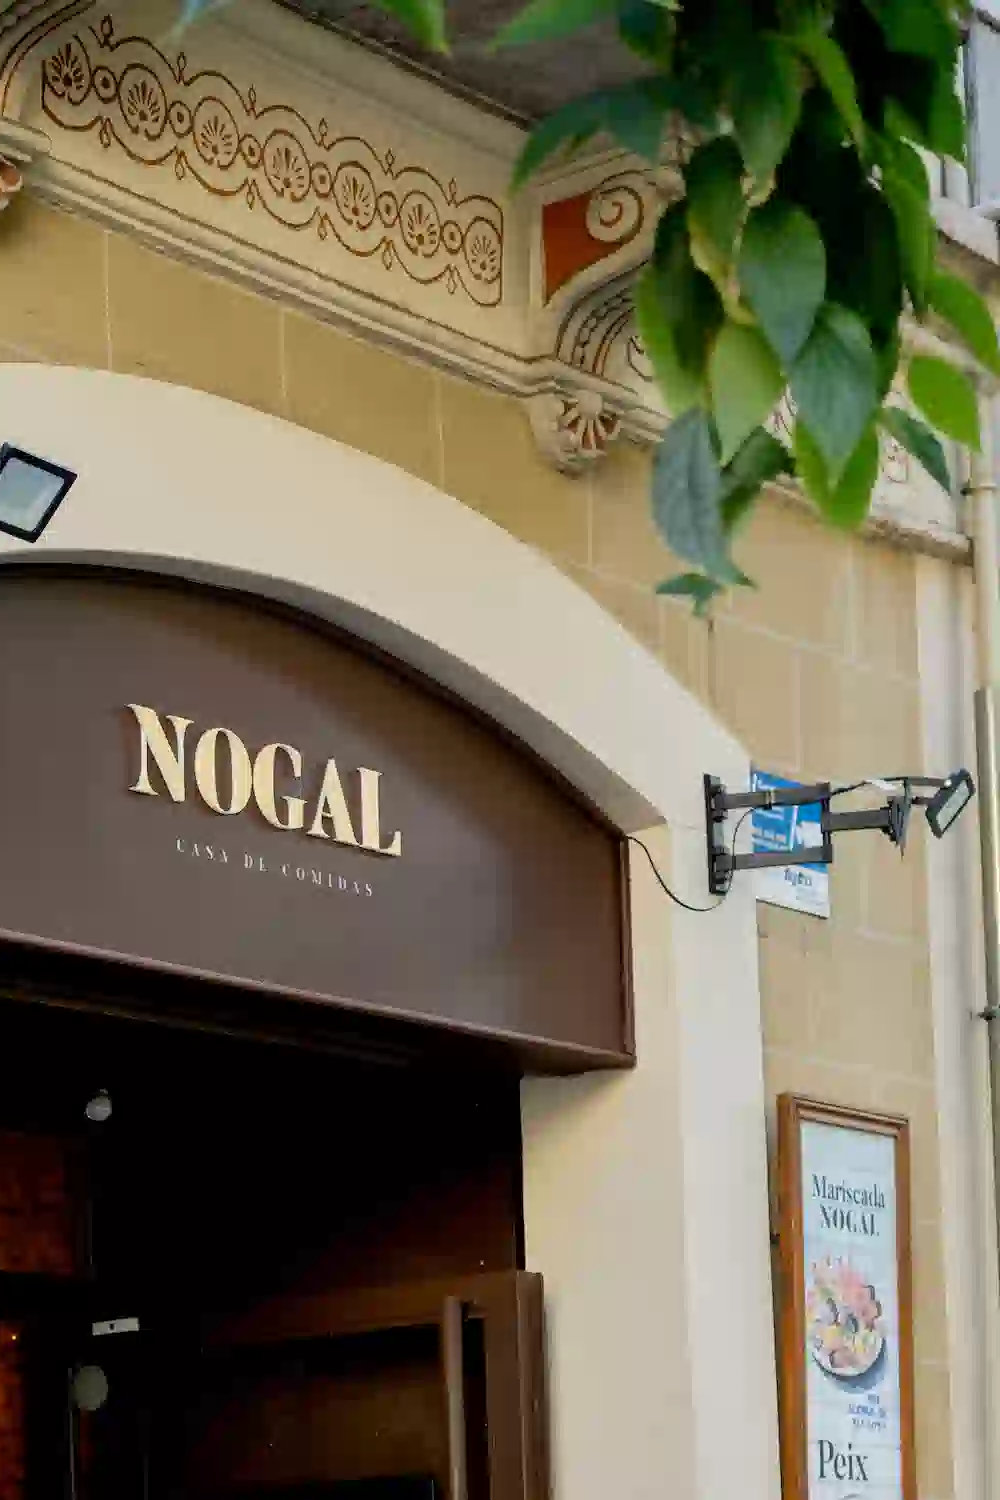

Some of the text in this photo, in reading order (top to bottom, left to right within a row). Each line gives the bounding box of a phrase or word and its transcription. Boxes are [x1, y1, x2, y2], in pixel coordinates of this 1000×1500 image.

[123, 703, 402, 857] NOGAL
[175, 836, 374, 898] CASA DE COMIDAS
[811, 1174, 885, 1209] Mariscada
[820, 1203, 880, 1237] NOGAL
[818, 1438, 869, 1482] Peix
